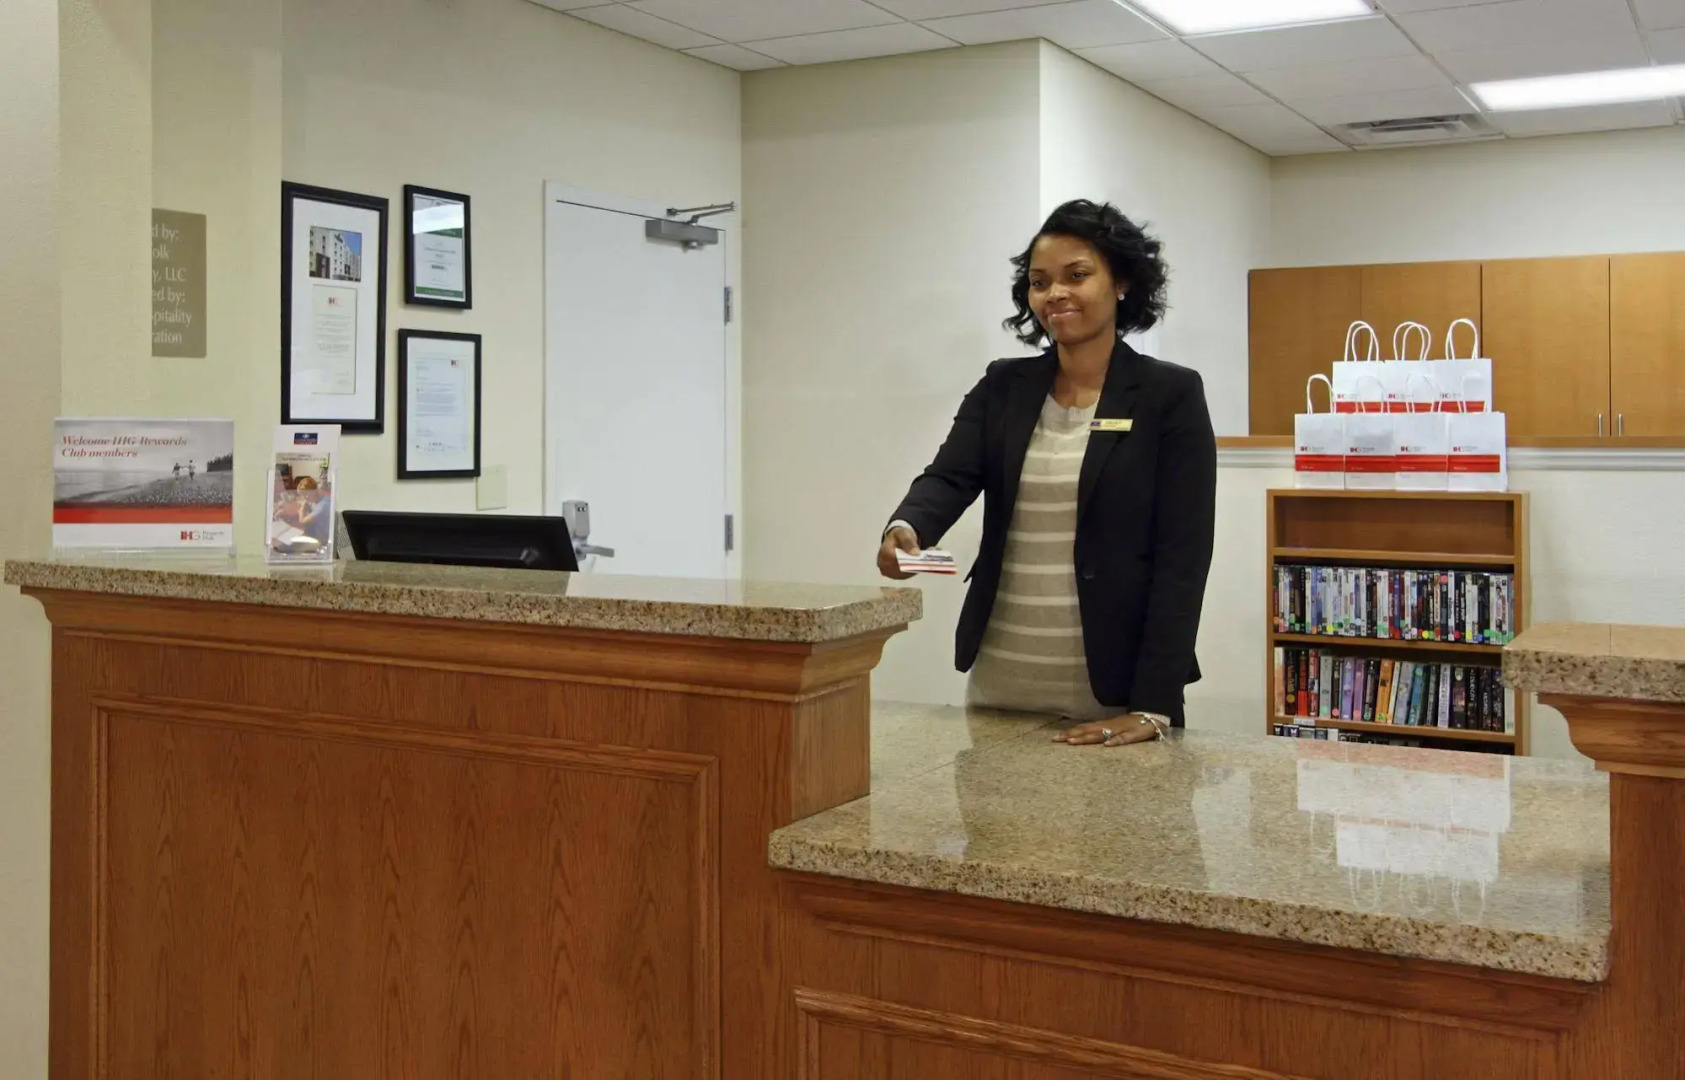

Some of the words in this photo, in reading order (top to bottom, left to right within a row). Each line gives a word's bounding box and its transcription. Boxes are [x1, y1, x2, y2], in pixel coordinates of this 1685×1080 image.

[166, 267, 187, 282] LLC
[152, 308, 193, 329] pitality
[62, 435, 110, 446] Welcome
[112, 436, 137, 446] IHG
[140, 436, 188, 446] Rewards
[61, 448, 87, 458] Club
[88, 448, 139, 458] members
